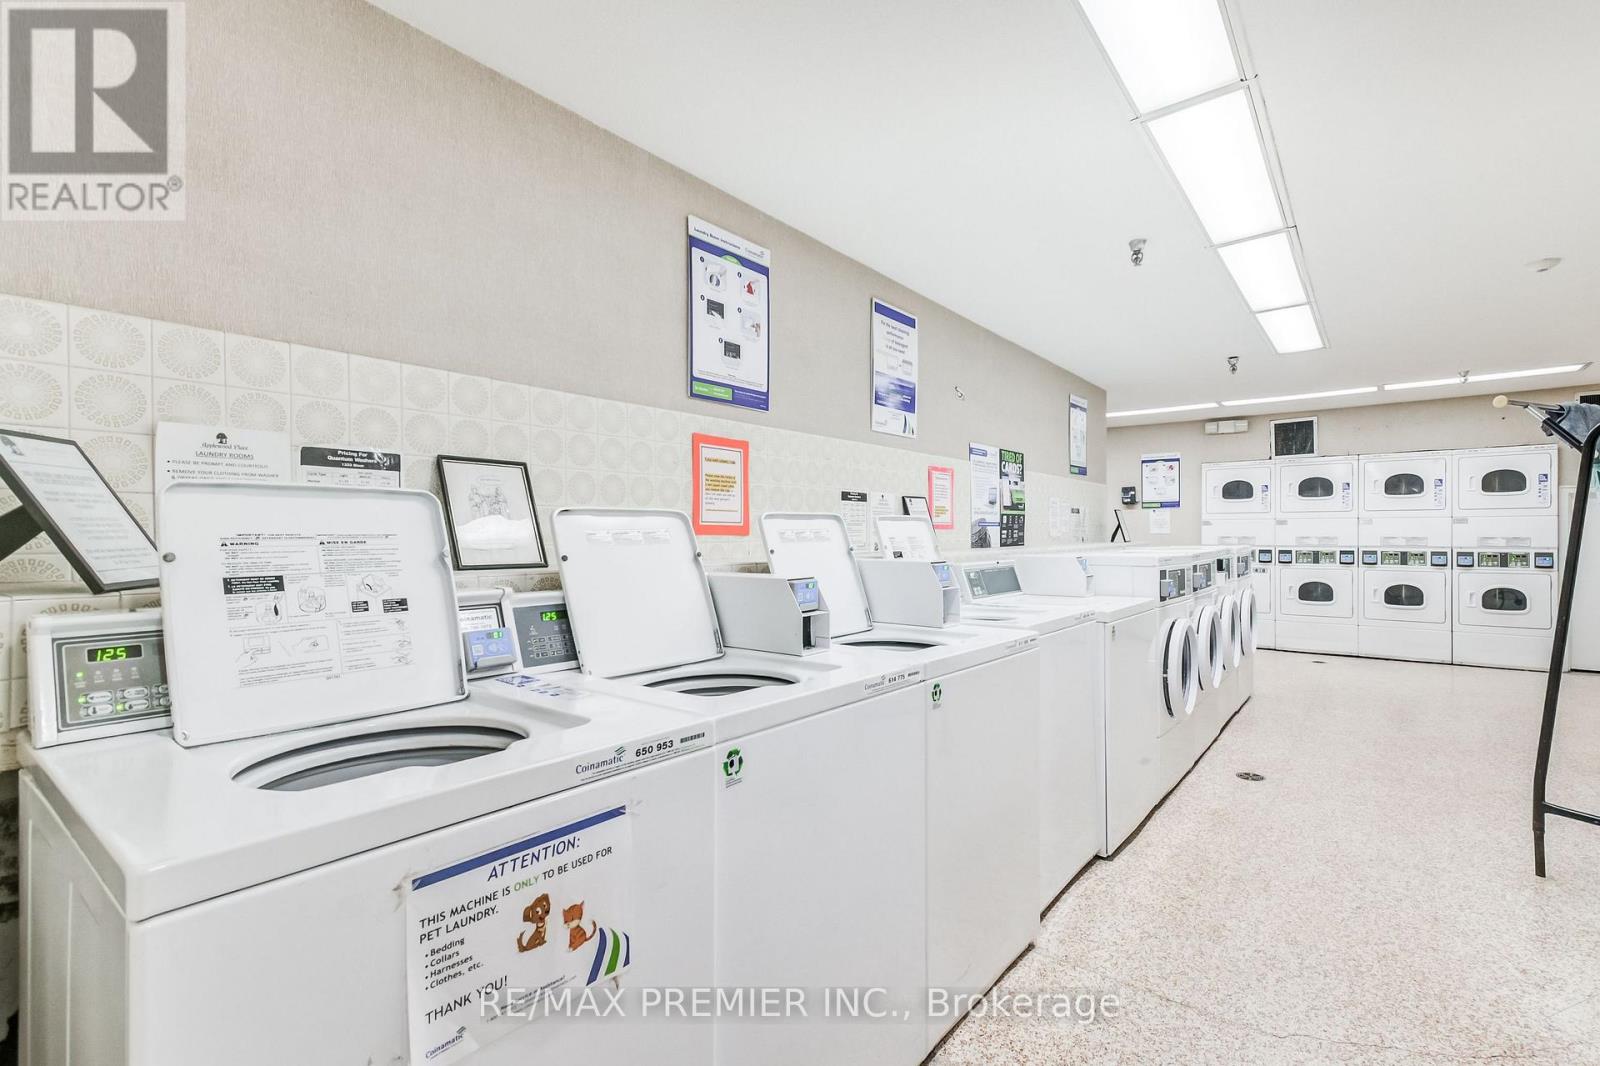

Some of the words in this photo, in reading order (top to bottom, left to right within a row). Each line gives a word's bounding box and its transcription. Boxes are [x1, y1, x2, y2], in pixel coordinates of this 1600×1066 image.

[229, 452, 254, 460] ROOMS
[576, 754, 624, 774] Coinamatic
[635, 746, 654, 758] 650
[656, 740, 674, 751] 953
[488, 836, 580, 881] ATTENTION:
[420, 912, 446, 929] THIS
[450, 891, 498, 918] MACHINE
[502, 887, 511, 897] IS
[514, 876, 540, 892] ONLY
[542, 869, 555, 881] TO
[558, 863, 569, 875] BE
[571, 854, 594, 870] USED
[596, 847, 613, 860] FOR
[419, 930, 440, 944] PET
[446, 905, 499, 932] LAUNDRY.
[430, 937, 465, 956] Bedding
[430, 950, 460, 967] Collars
[430, 955, 473, 978] Harnesses
[430, 970, 465, 989] Clothes,
[468, 962, 484, 973] etc.
[425, 993, 472, 1024] THANK
[477, 976, 508, 998] YOU!
[425, 1033, 464, 1059] Coinamatic
